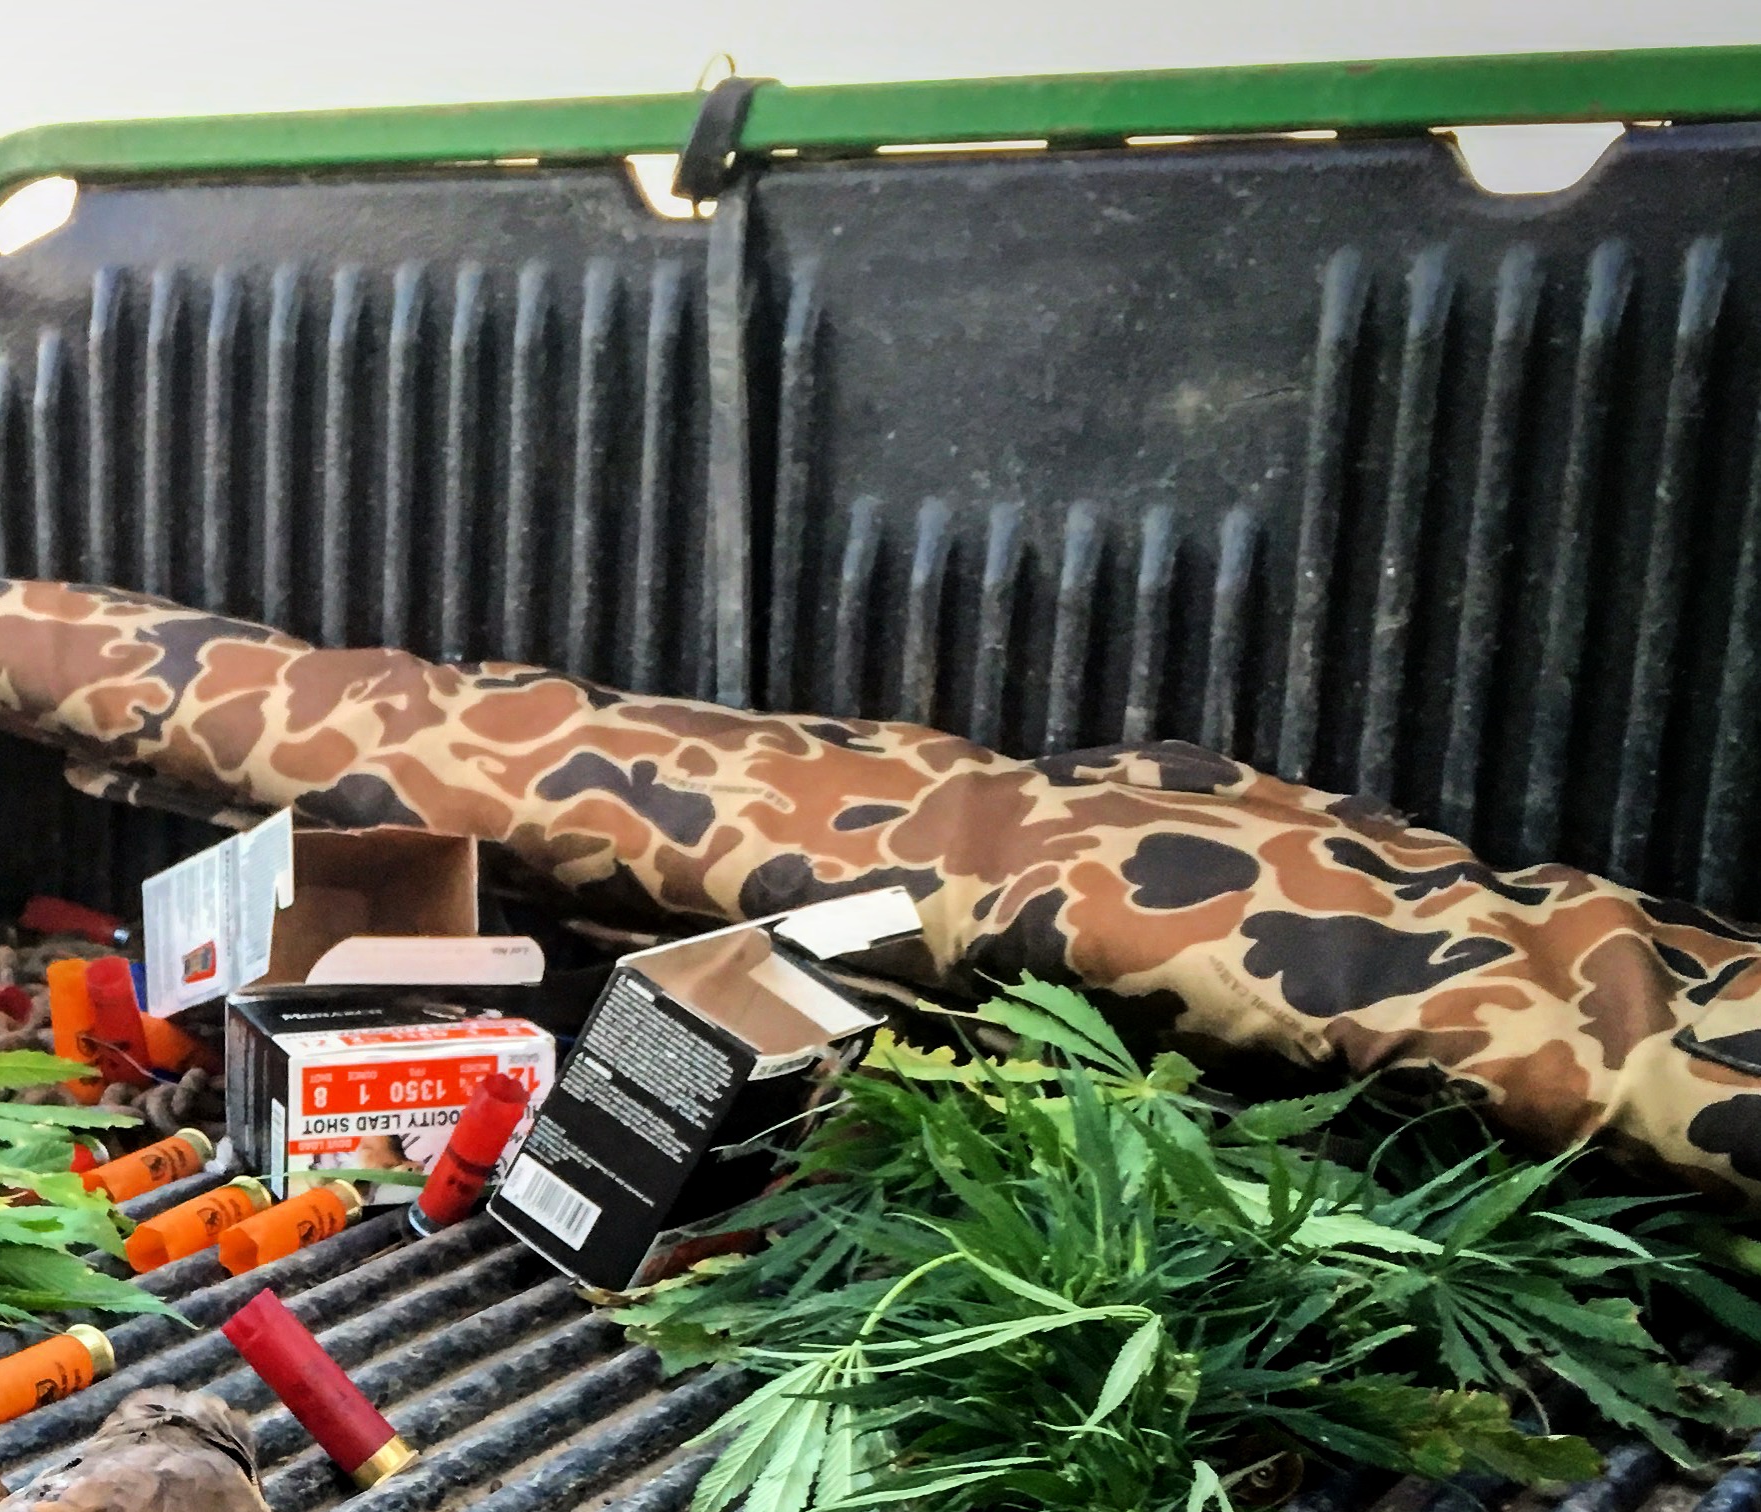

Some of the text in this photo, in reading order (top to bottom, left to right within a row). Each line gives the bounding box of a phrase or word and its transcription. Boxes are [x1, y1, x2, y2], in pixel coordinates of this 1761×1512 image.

[313, 1086, 328, 1109] 8
[359, 1083, 370, 1106] 1
[389, 1079, 447, 1103] 1350
[302, 1109, 461, 1136] OCITY LEAD SHOT
